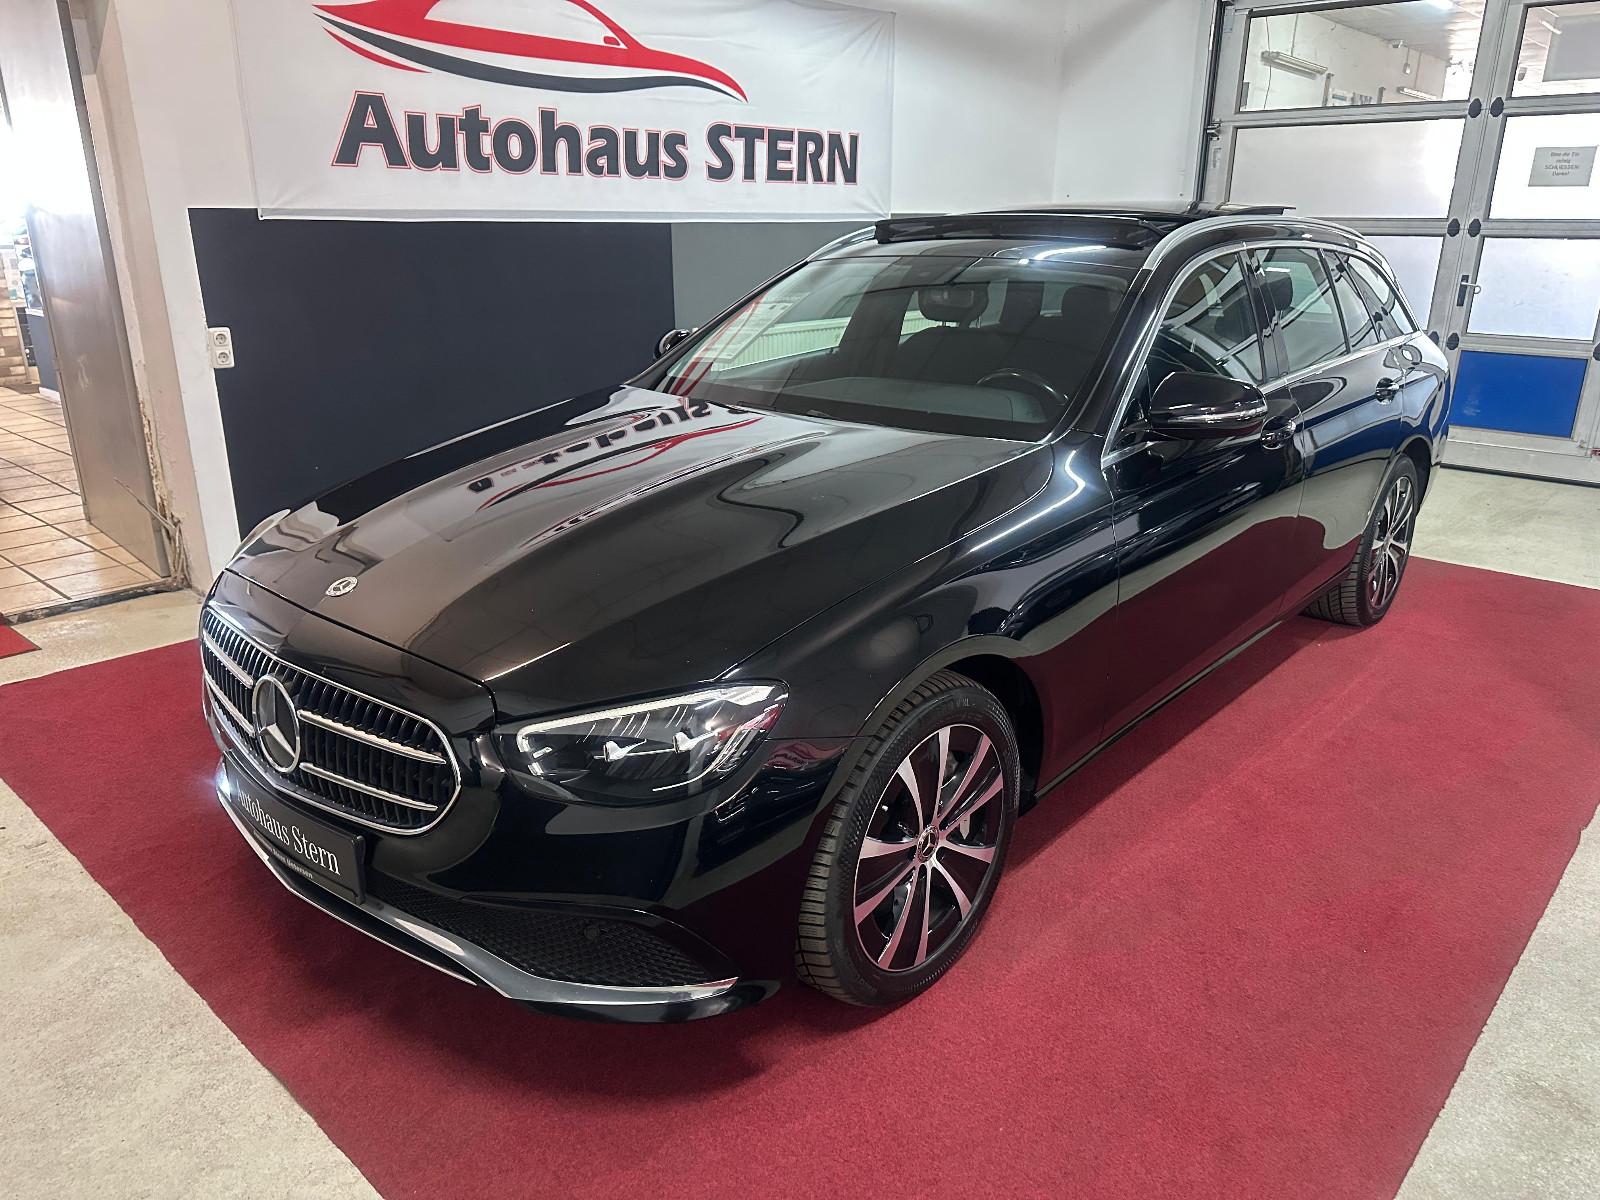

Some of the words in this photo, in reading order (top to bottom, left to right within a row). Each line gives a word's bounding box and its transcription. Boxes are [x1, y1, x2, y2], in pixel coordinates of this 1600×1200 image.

[331, 90, 689, 181] Autohaus
[705, 121, 859, 185] STERN
[291, 825, 341, 876] Stern
